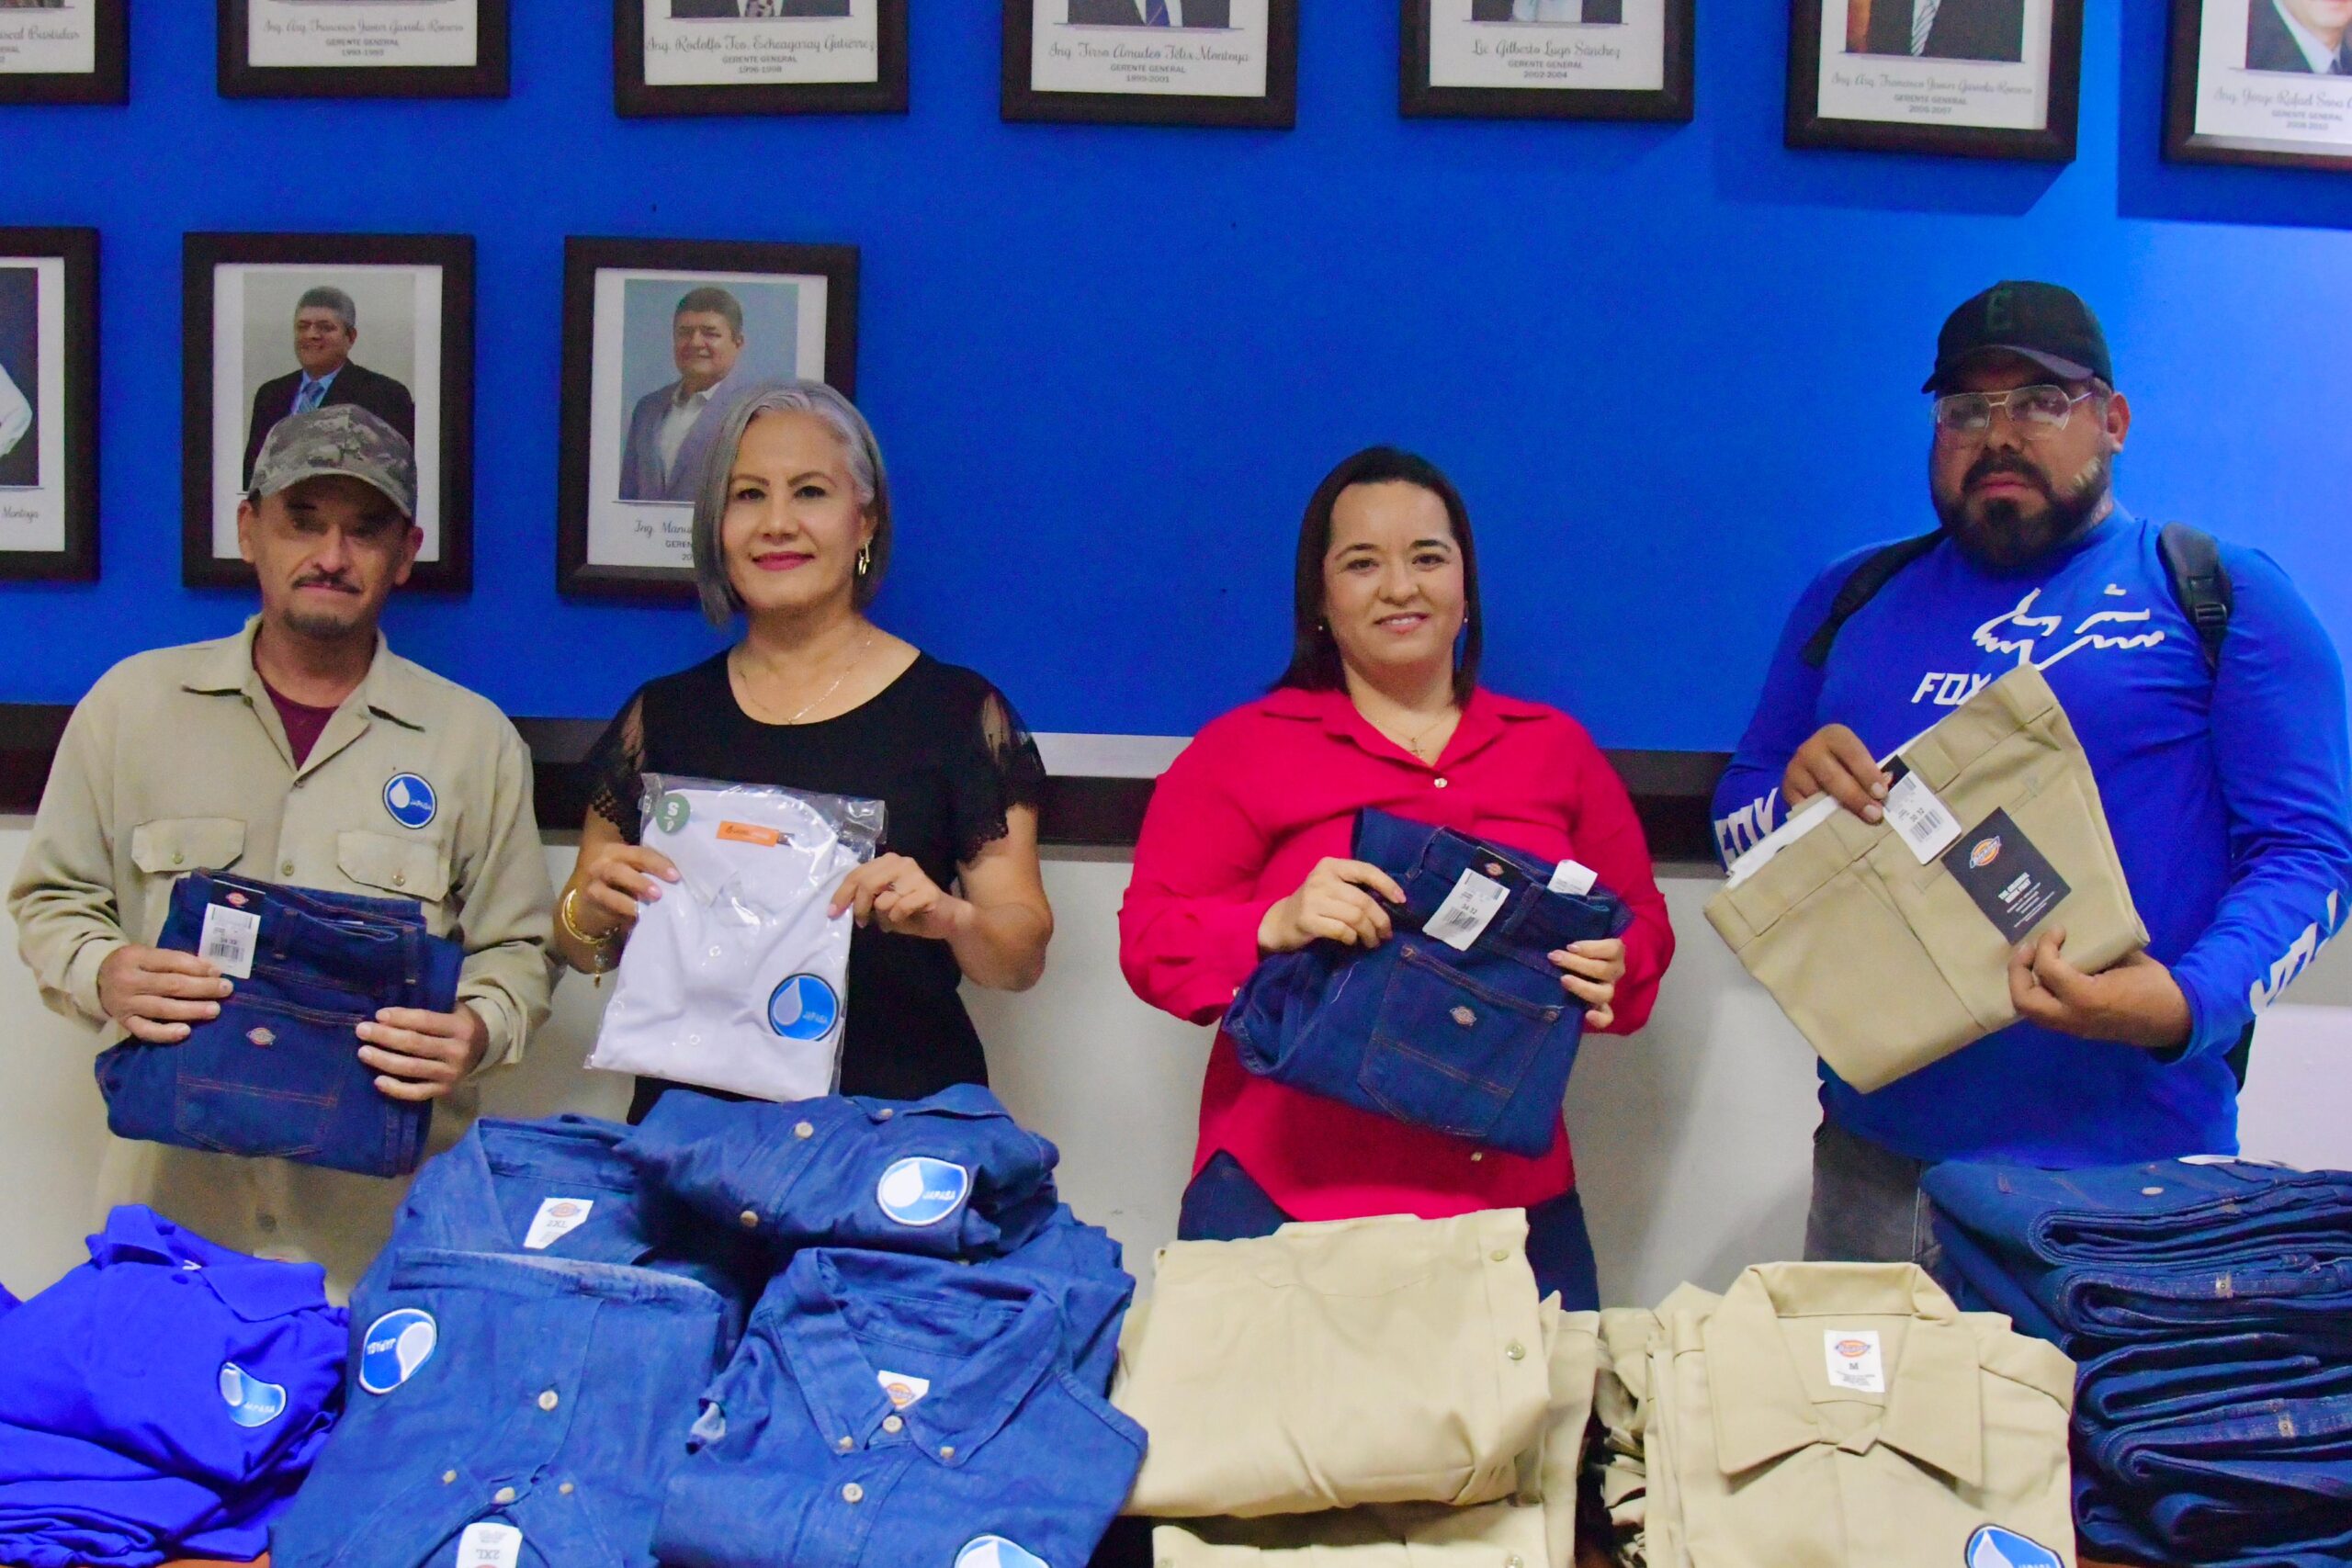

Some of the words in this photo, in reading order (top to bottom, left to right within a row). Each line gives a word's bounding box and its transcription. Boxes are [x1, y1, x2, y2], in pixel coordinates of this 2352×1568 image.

[1496, 39, 1541, 57] Gilberto
[722, 56, 758, 64] GERENTE
[1508, 60, 1544, 68] GERENTE
[1545, 60, 1583, 69] GENERAL
[1110, 63, 1147, 72] GERENTE
[1148, 65, 1186, 73] GENERAL
[1523, 71, 1568, 79] 2002-2004
[1894, 94, 1929, 102] GERENTE
[1930, 96, 1968, 105] GENERAL
[662, 521, 693, 534] Manu
[665, 540, 693, 548] GEREN
[1911, 672, 1992, 705] FOX
[667, 801, 680, 817] S
